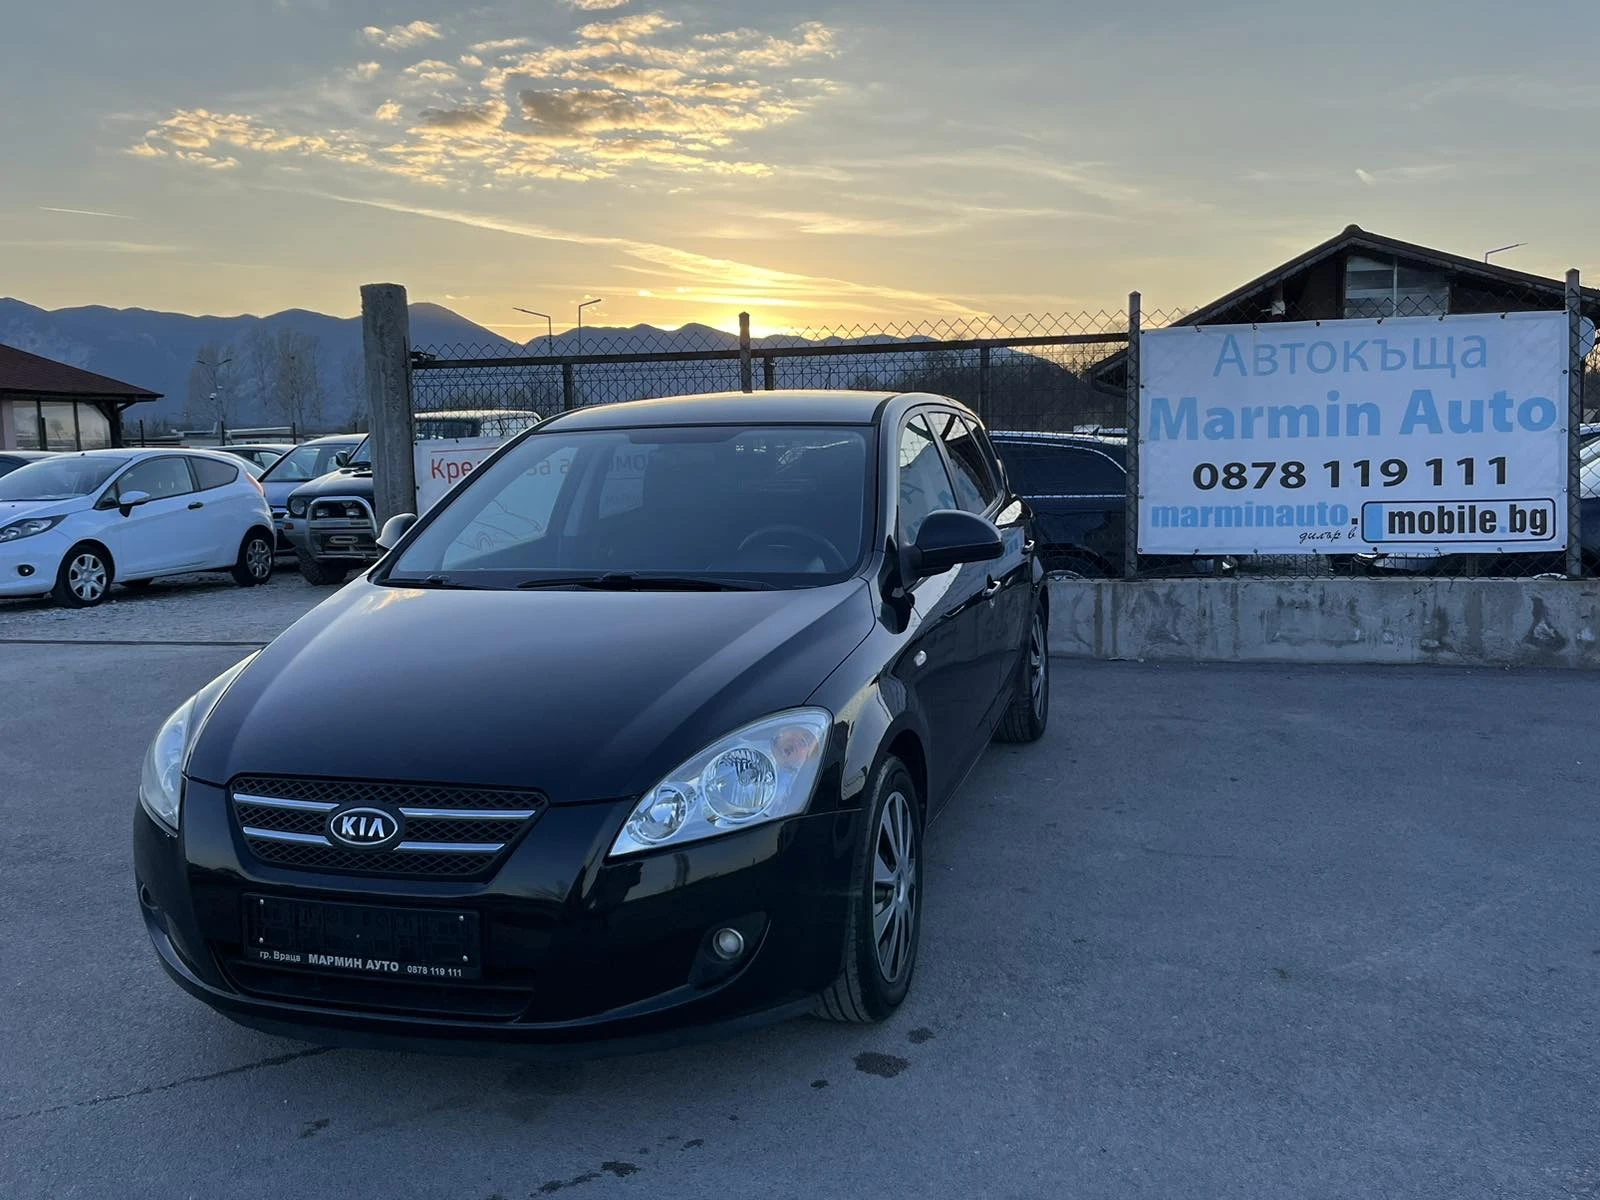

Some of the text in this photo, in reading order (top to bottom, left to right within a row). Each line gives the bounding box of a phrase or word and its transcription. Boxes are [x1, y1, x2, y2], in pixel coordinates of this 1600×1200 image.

[1213, 332, 1487, 378] Автокъща
[1149, 389, 1557, 441] Marmin Auto
[1192, 456, 1507, 490] 0878 119 111
[1388, 504, 1547, 536] mobile.bg
[1299, 530, 1342, 544] дилър
[341, 815, 386, 838] KIA
[259, 951, 462, 977] гр. Враца МАРМИН АУТО 0878 119 111
